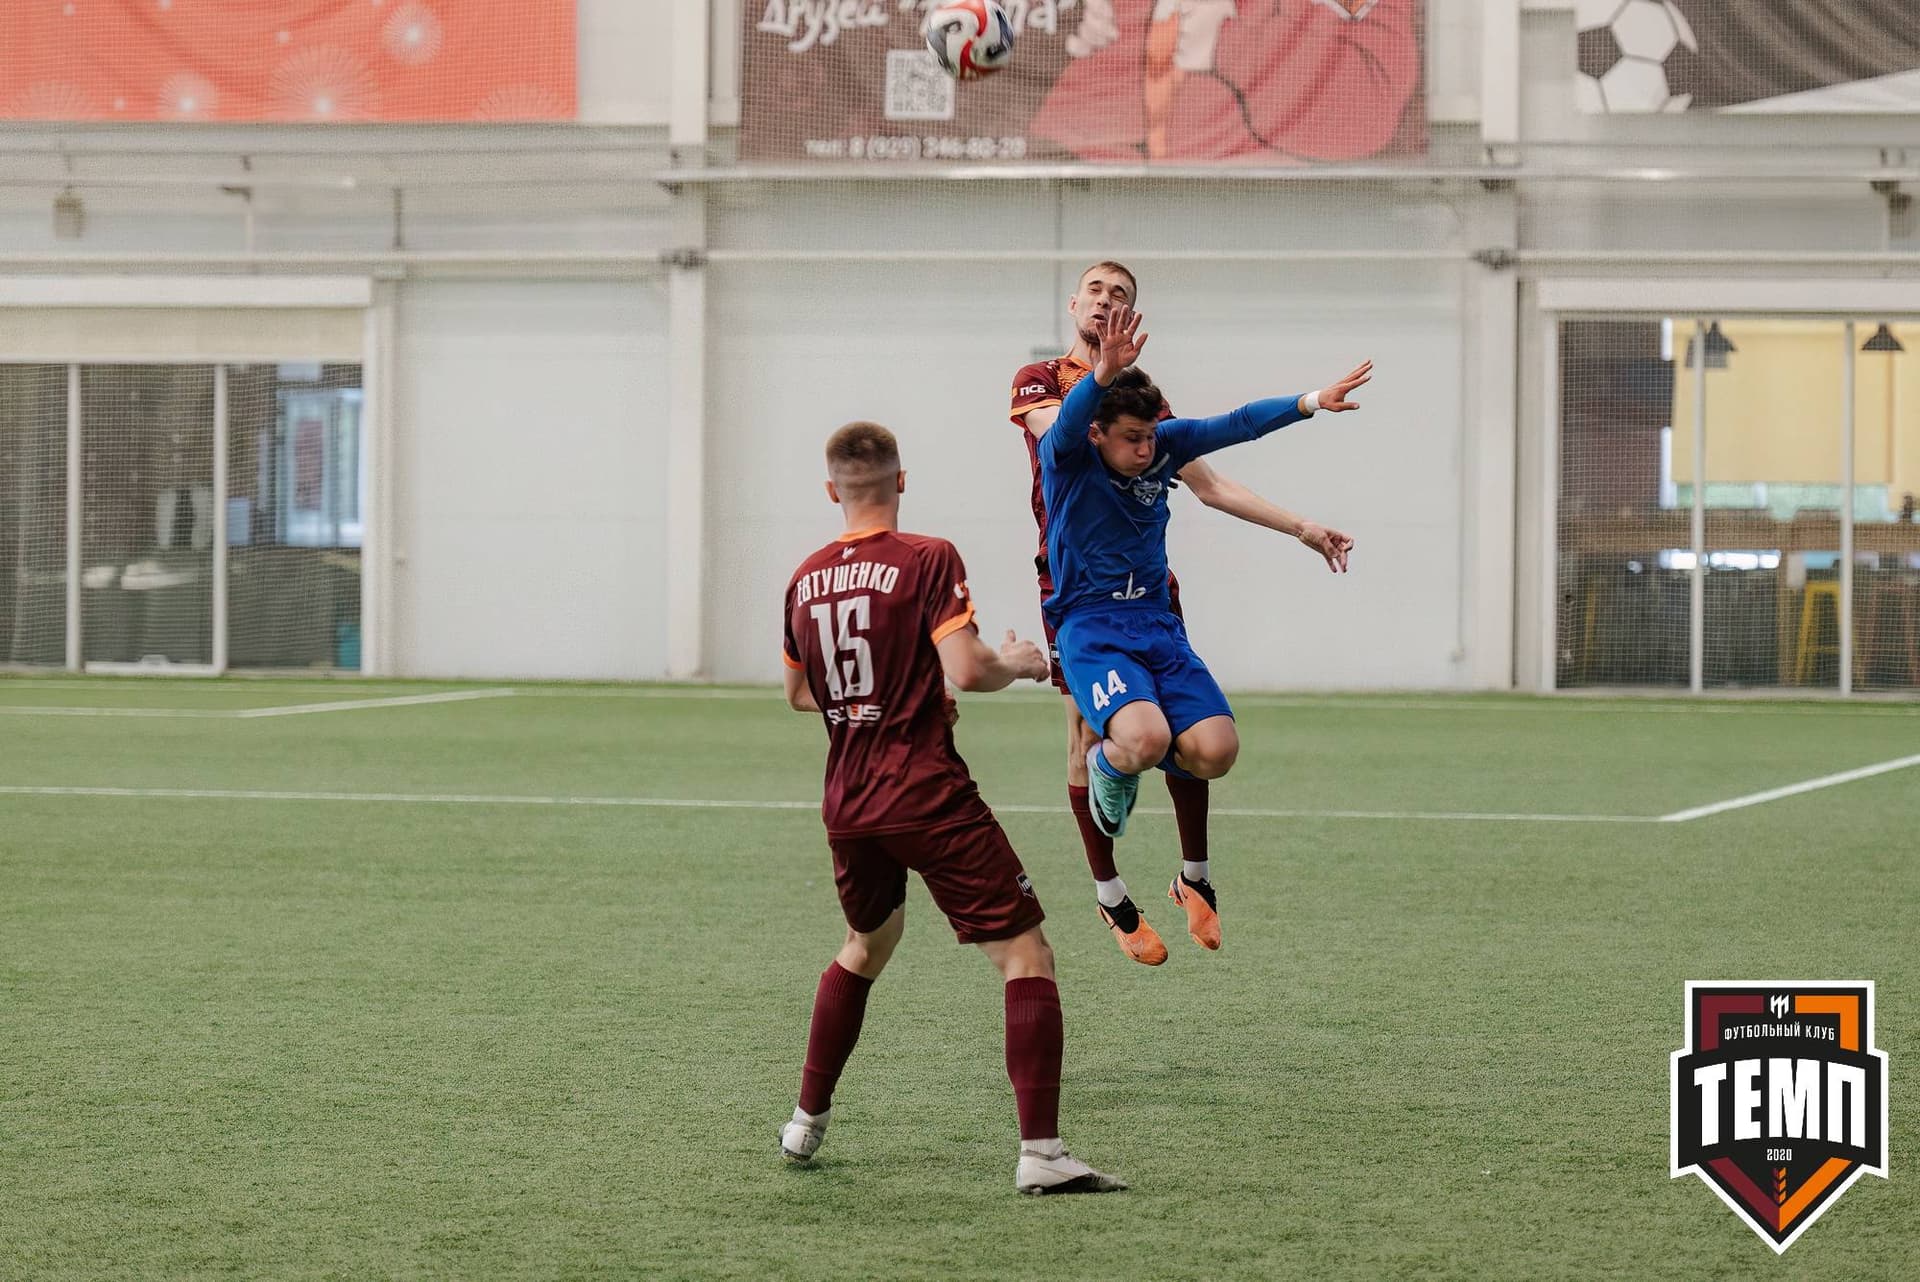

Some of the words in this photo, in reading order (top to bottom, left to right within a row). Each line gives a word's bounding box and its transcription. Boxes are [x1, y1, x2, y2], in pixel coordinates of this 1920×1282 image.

[796, 561, 900, 607] ЕВТУШЕНКО
[810, 595, 875, 700] 15
[1091, 669, 1128, 711] 44
